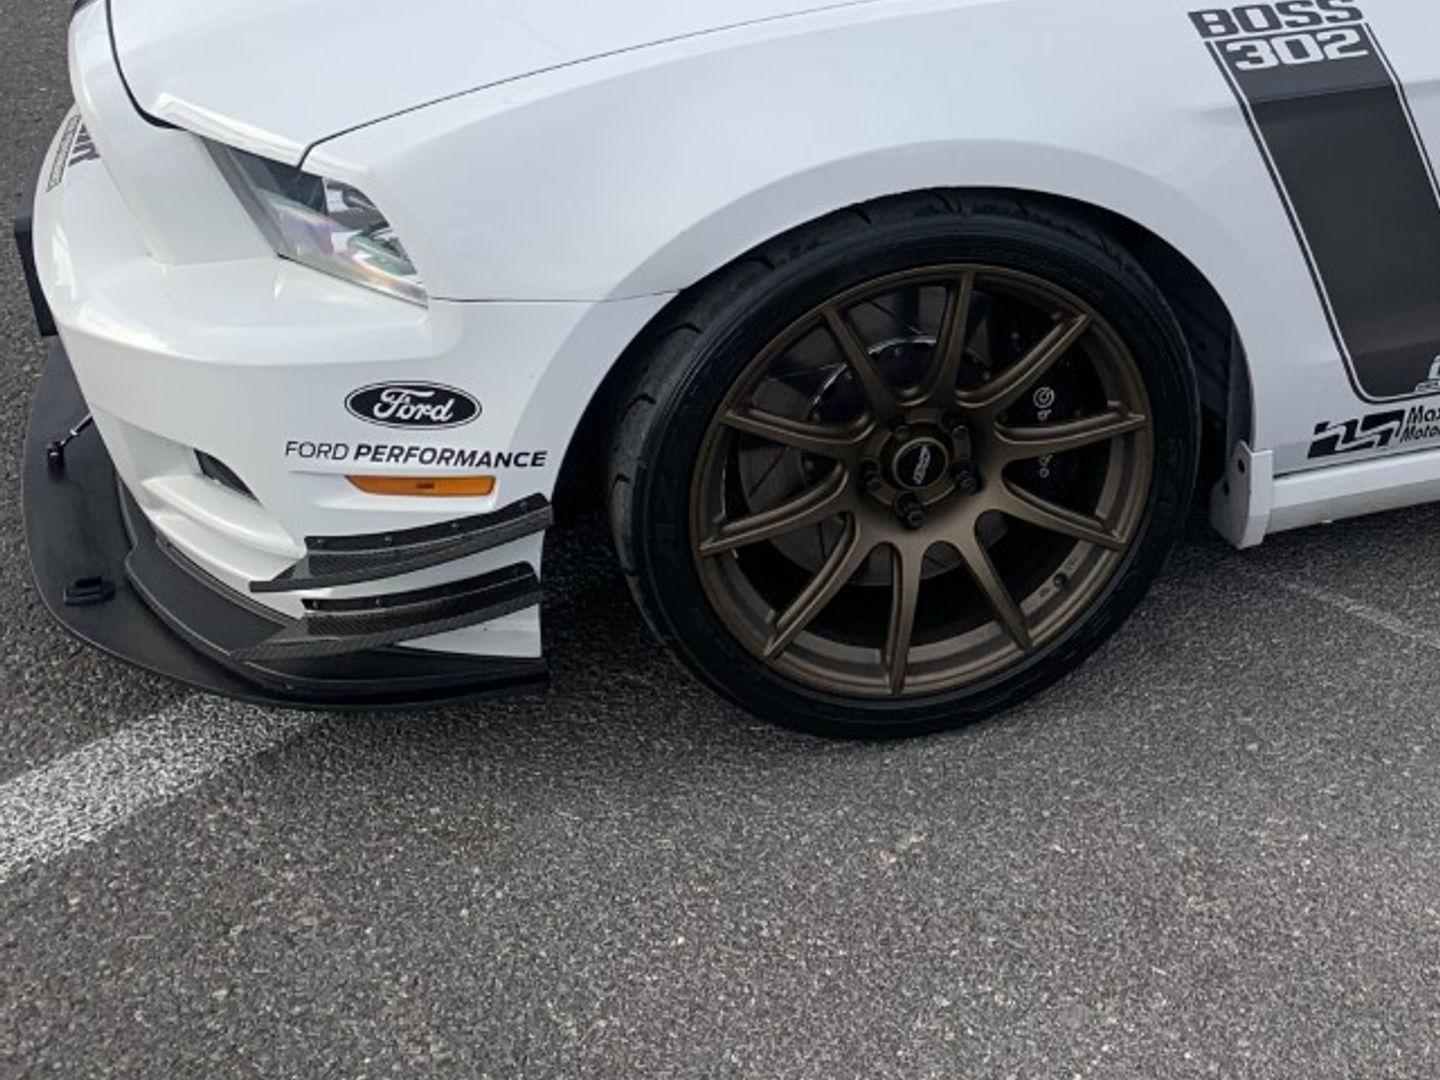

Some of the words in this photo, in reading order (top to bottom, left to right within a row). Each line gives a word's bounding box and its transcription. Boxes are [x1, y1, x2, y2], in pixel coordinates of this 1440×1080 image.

[1226, 29, 1369, 71] 302
[373, 387, 455, 422] Ford
[285, 441, 349, 460] FORD
[353, 443, 548, 469] PERFORMANCE
